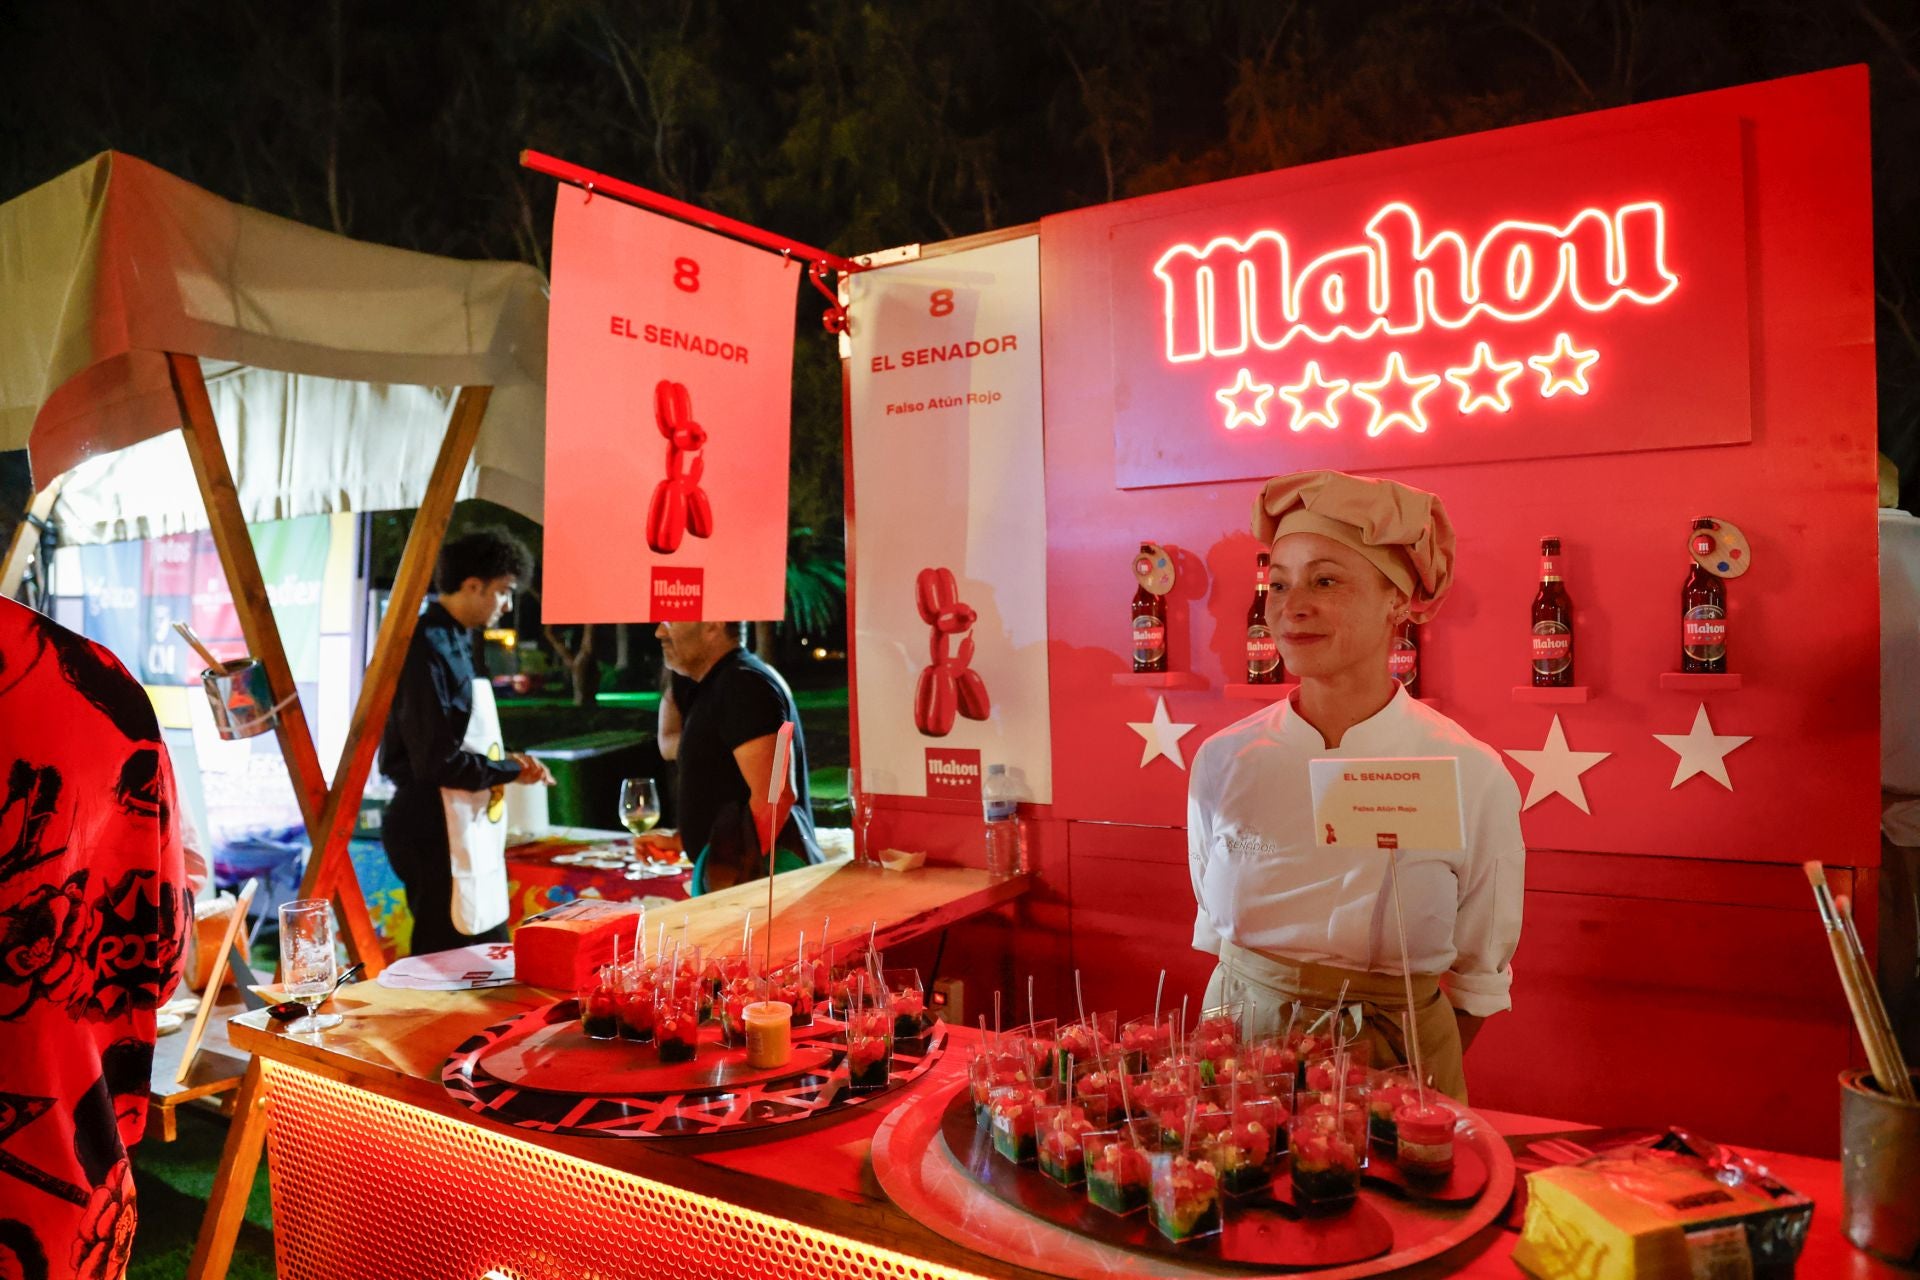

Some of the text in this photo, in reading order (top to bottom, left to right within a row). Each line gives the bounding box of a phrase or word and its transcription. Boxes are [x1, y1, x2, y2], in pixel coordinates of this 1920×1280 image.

[673, 257, 700, 293] 8
[1153, 202, 1681, 363] Mahou
[929, 288, 954, 317] 8
[610, 316, 749, 364] EL SENADOR
[871, 335, 1018, 373] EL SENADOR
[886, 390, 1002, 416] Falso Atún Rojo
[653, 579, 701, 598] Mahou
[1687, 622, 1725, 634] Mahou
[1533, 638, 1568, 650] Mahou
[928, 759, 979, 776] Mahou
[1343, 772, 1421, 781] EL SENADOR
